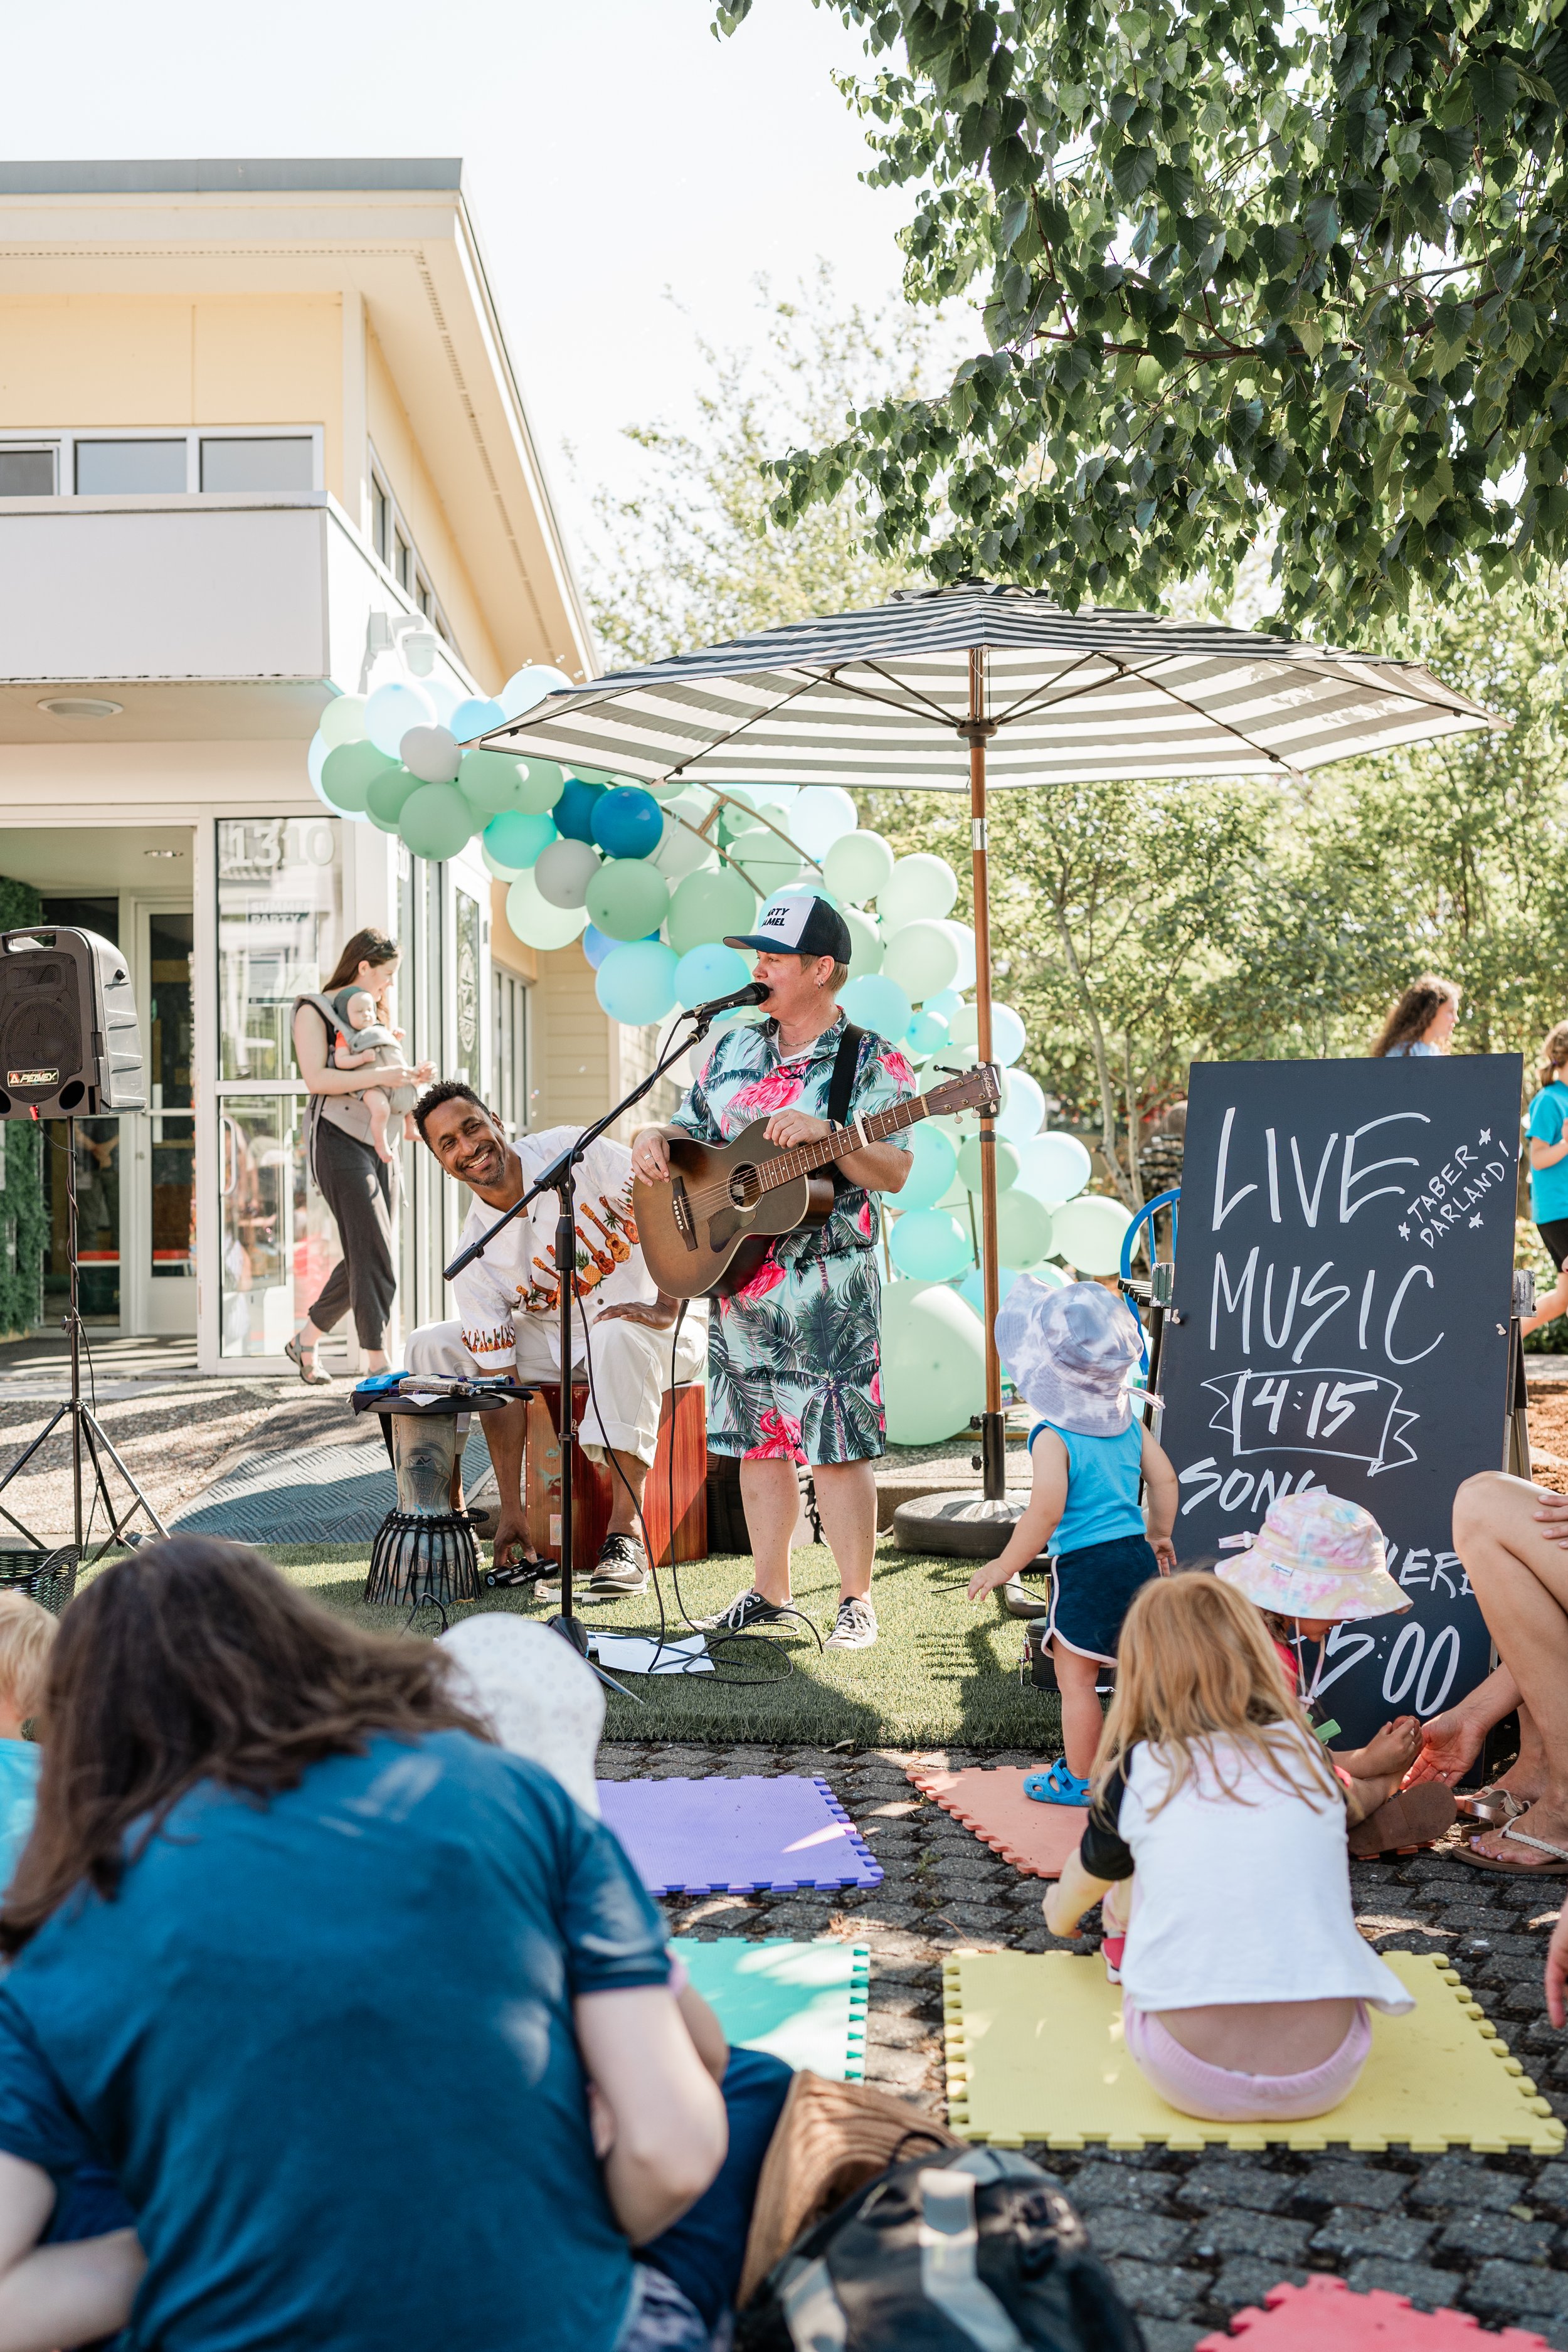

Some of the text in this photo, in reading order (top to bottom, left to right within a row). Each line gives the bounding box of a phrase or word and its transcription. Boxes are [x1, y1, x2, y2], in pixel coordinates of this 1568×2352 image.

[228, 825, 334, 867] 1310
[252, 914, 300, 926] PARTY
[19, 1073, 57, 1083] PEAVEY
[1212, 1107, 1431, 1231] LIVE
[1407, 1145, 1478, 1224] TABER
[1421, 1140, 1517, 1248] DARLAND!
[1210, 1247, 1444, 1364] MUSIC
